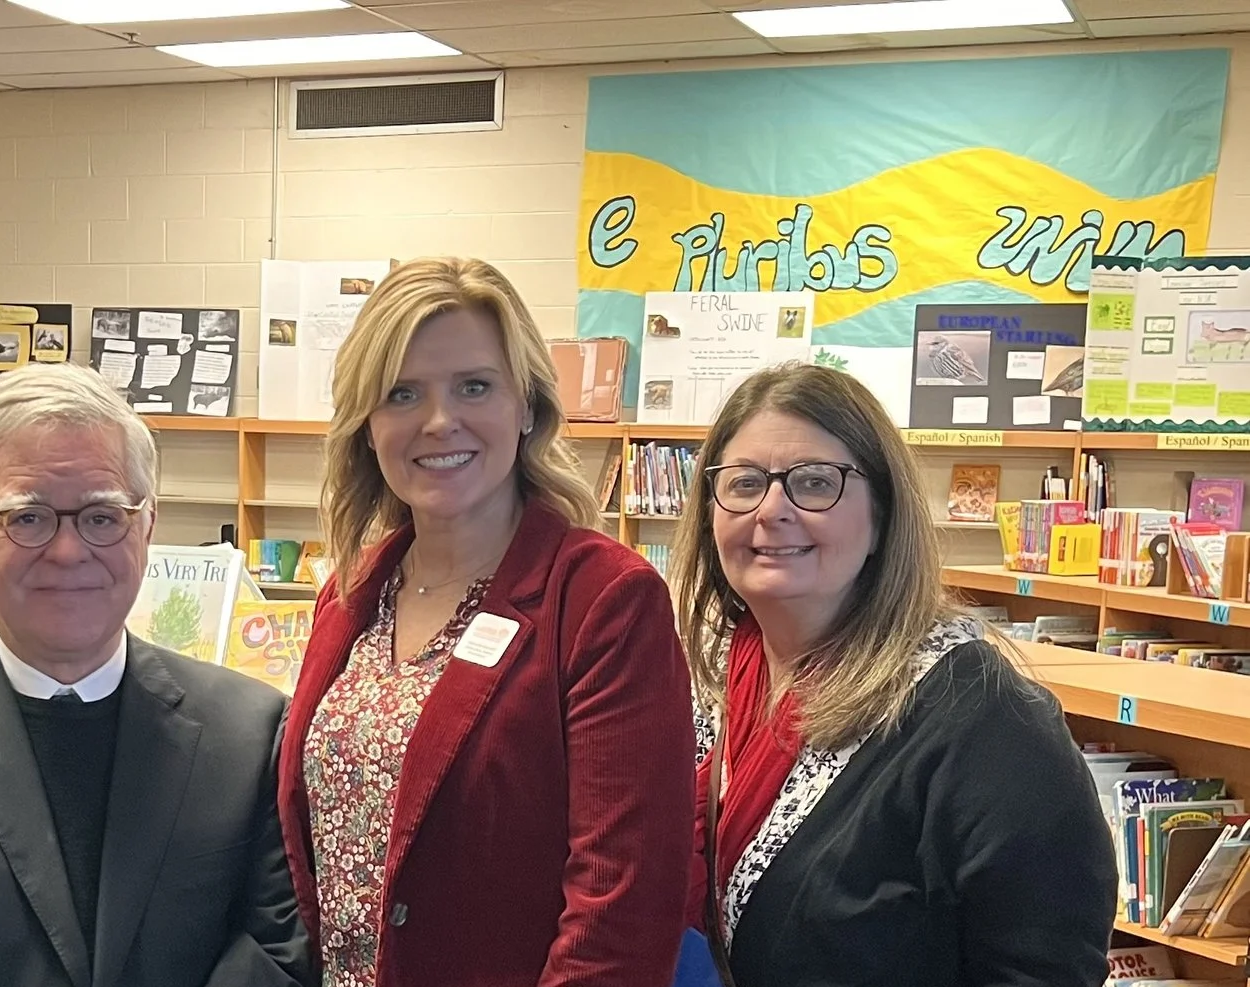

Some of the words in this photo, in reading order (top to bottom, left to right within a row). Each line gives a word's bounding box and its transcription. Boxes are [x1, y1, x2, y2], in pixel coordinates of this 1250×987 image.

[589, 195, 638, 268] e
[690, 294, 739, 313] FERAL
[717, 312, 769, 332] SWINE
[937, 314, 1023, 330] EUROPEAN
[995, 329, 1078, 346] STARLING
[907, 431, 949, 444] Español
[959, 431, 1002, 444] Spanish
[1165, 434, 1211, 448] Español
[164, 558, 200, 581] VERY
[1018, 579, 1031, 595] W
[242, 610, 313, 650] CHA
[1120, 697, 1132, 722] R
[1135, 787, 1176, 803] What
